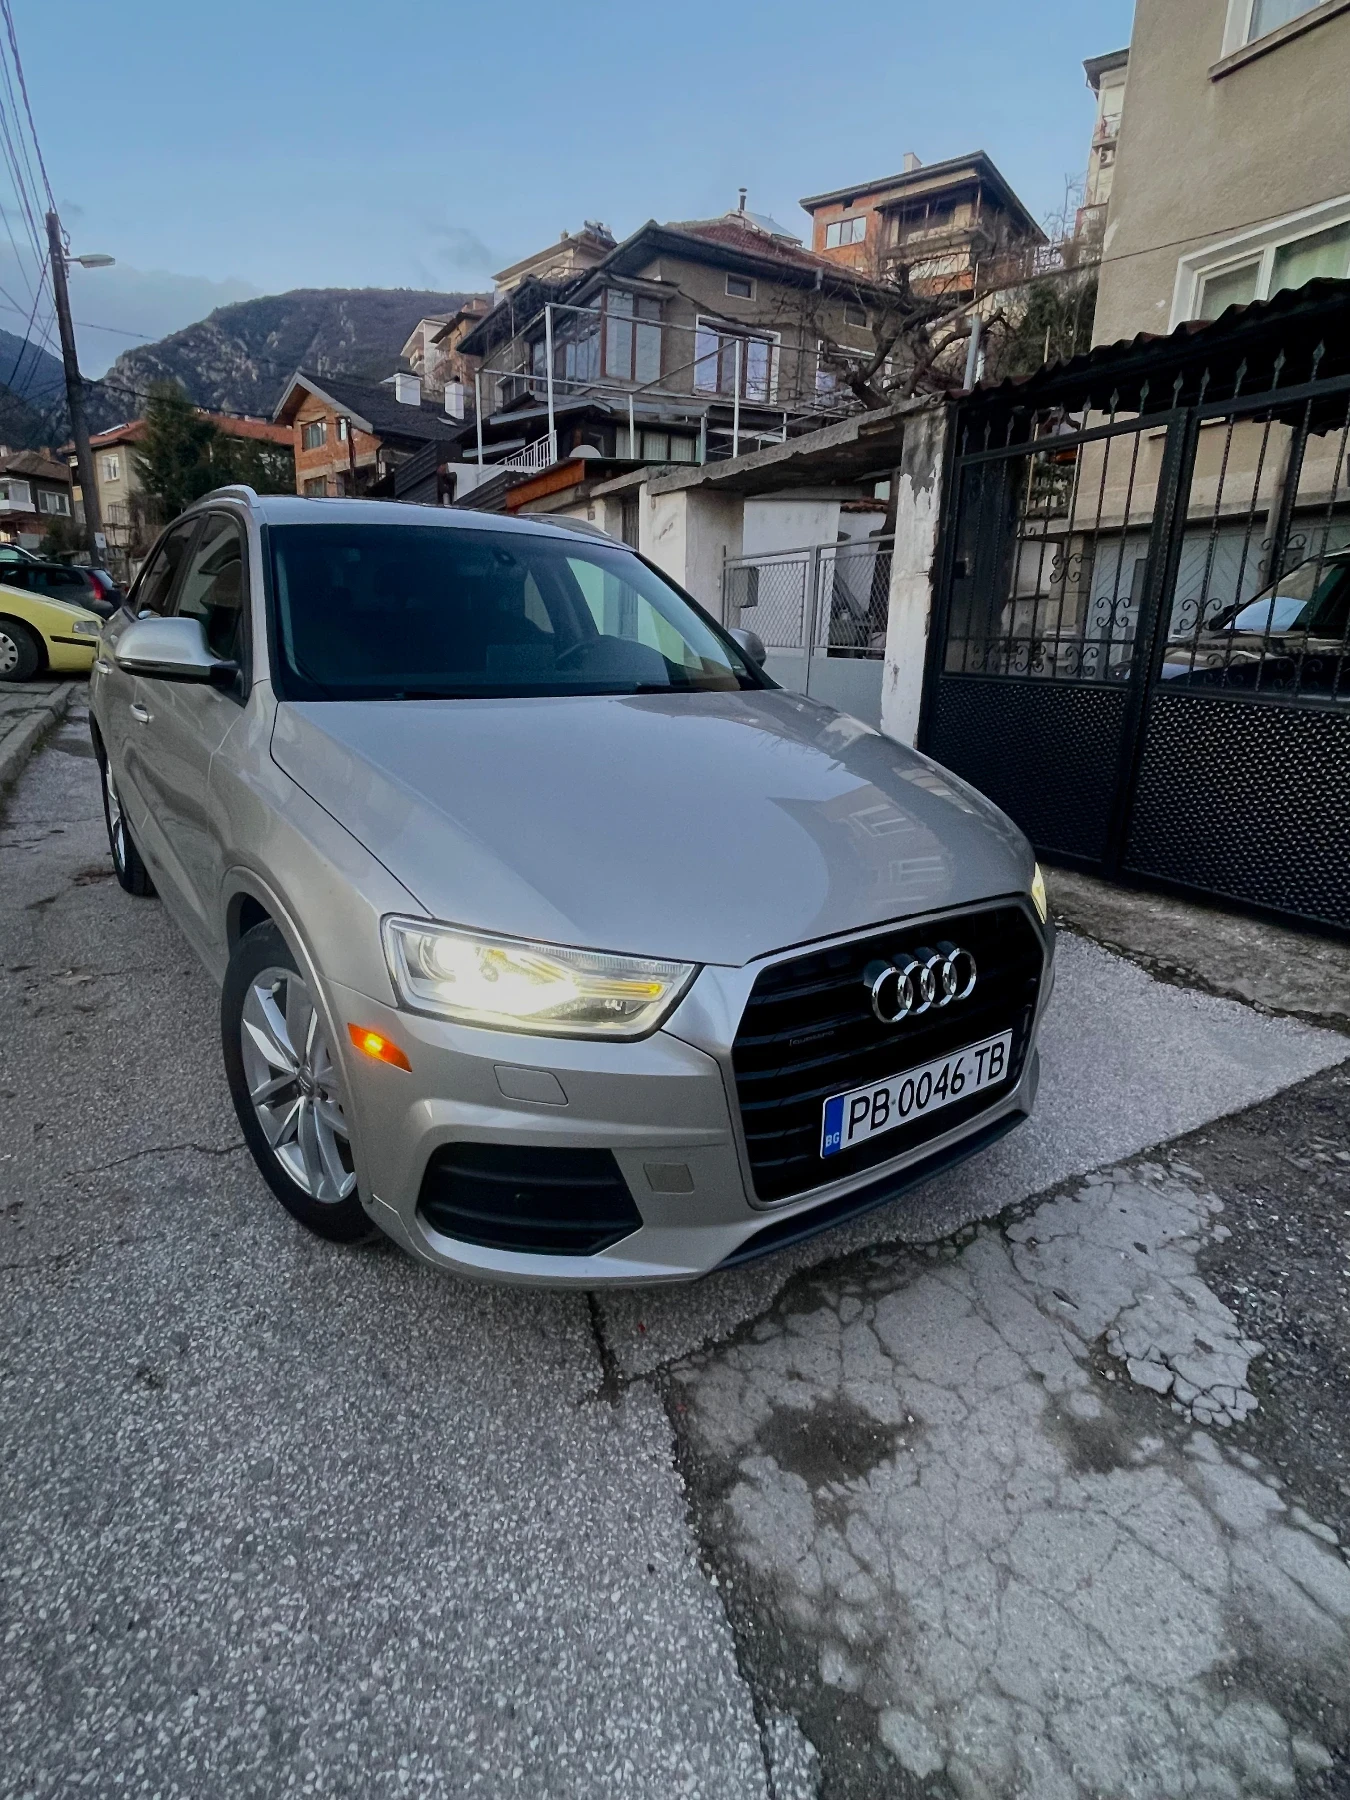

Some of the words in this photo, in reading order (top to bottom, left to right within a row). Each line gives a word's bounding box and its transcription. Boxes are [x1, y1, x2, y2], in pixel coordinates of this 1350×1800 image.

[847, 1087, 890, 1140] PB
[897, 1056, 966, 1118] 0046
[974, 1041, 1005, 1086] TB
[825, 1131, 840, 1148] BG
